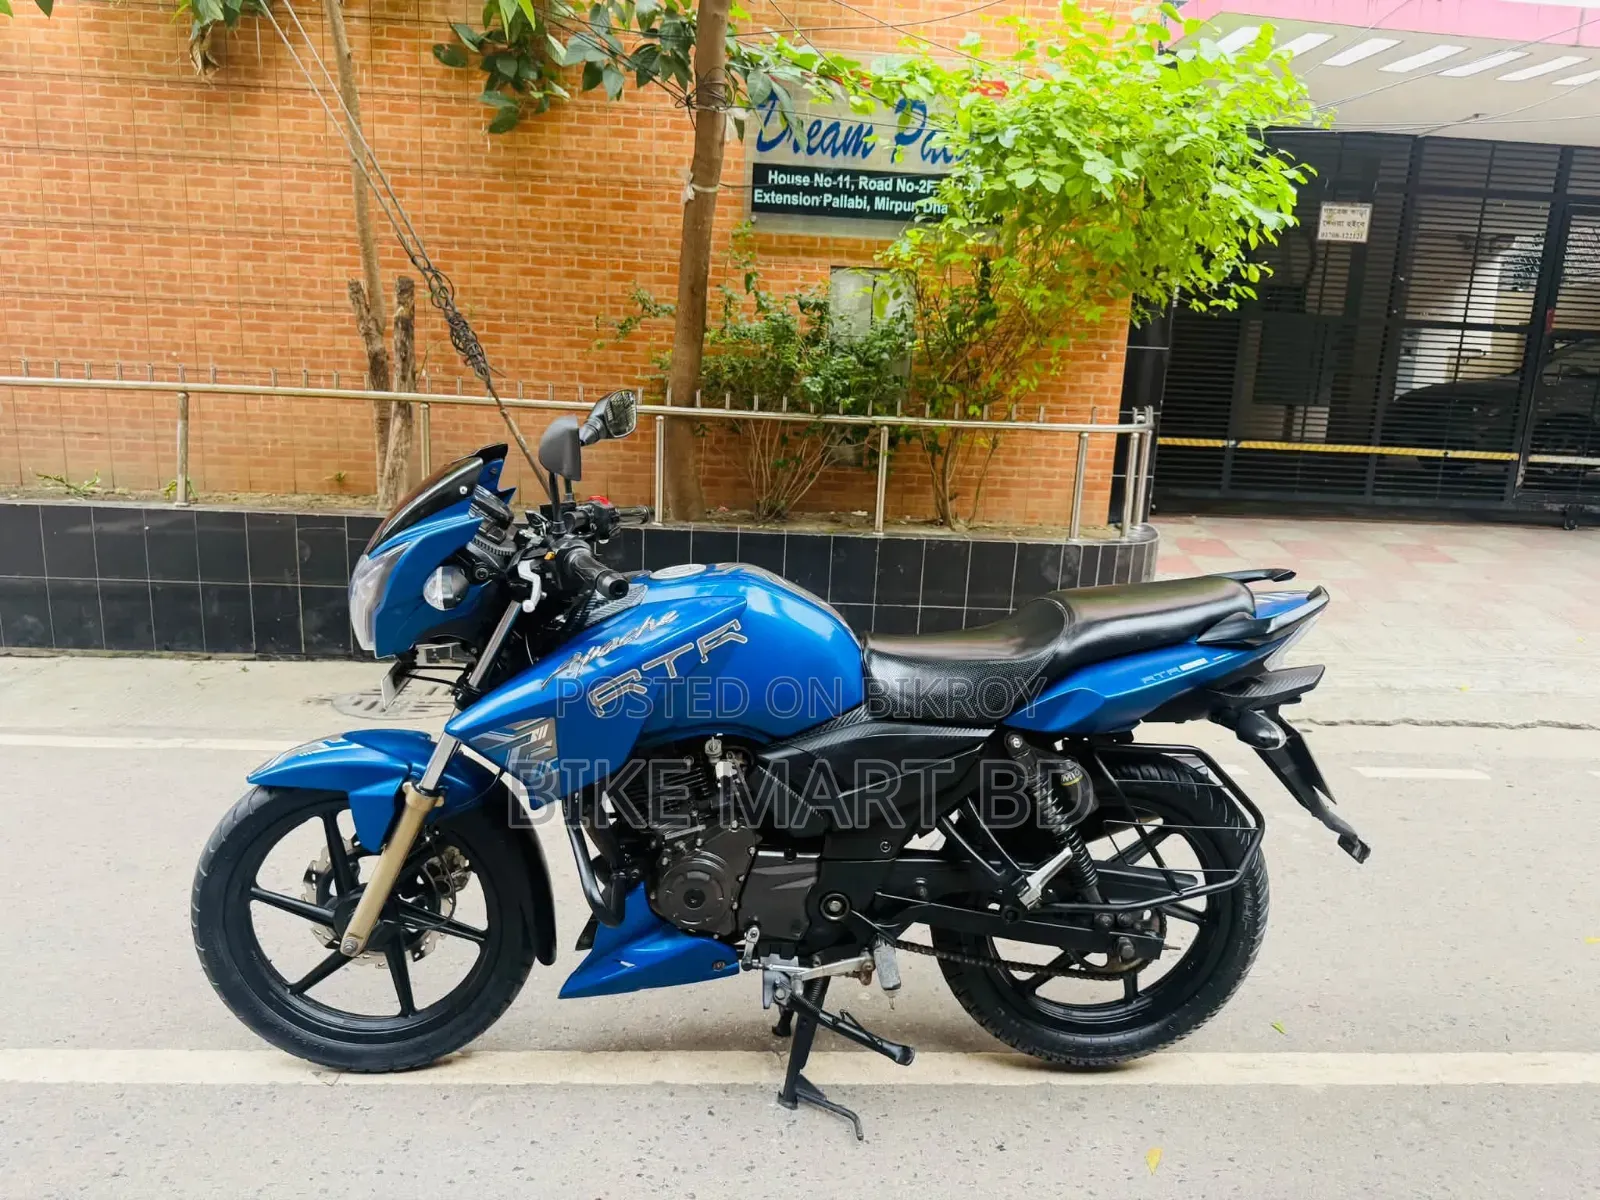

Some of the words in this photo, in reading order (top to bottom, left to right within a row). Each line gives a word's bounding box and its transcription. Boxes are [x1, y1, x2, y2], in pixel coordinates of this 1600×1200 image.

[768, 169, 811, 187] House
[813, 172, 855, 191] No-11,
[858, 175, 893, 192] Road
[754, 188, 820, 207] Extension
[823, 193, 871, 212] Pallabi,
[588, 618, 748, 717] RTR
